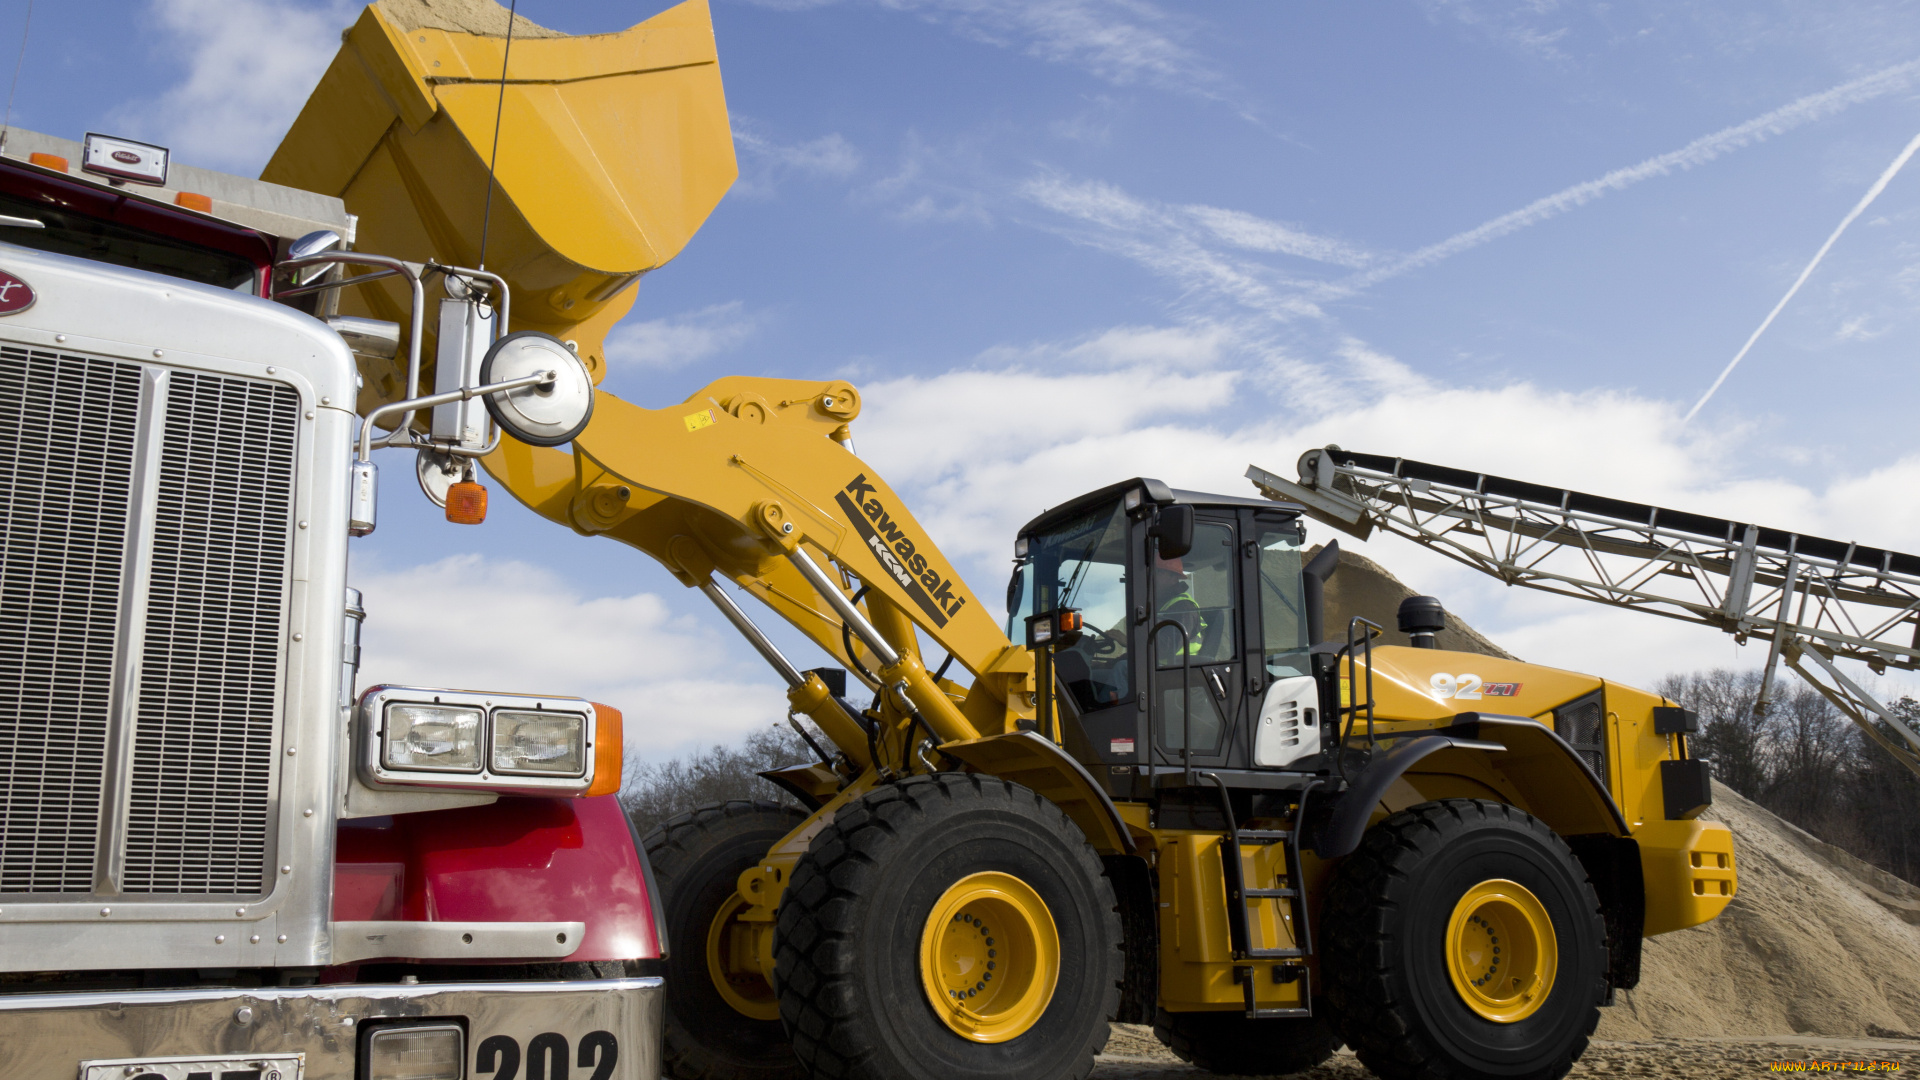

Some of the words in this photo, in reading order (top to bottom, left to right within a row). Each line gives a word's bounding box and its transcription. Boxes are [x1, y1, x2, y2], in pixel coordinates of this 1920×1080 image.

[845, 473, 966, 618] Kawasaki
[868, 534, 913, 588] KCM
[476, 1030, 619, 1080] 202
